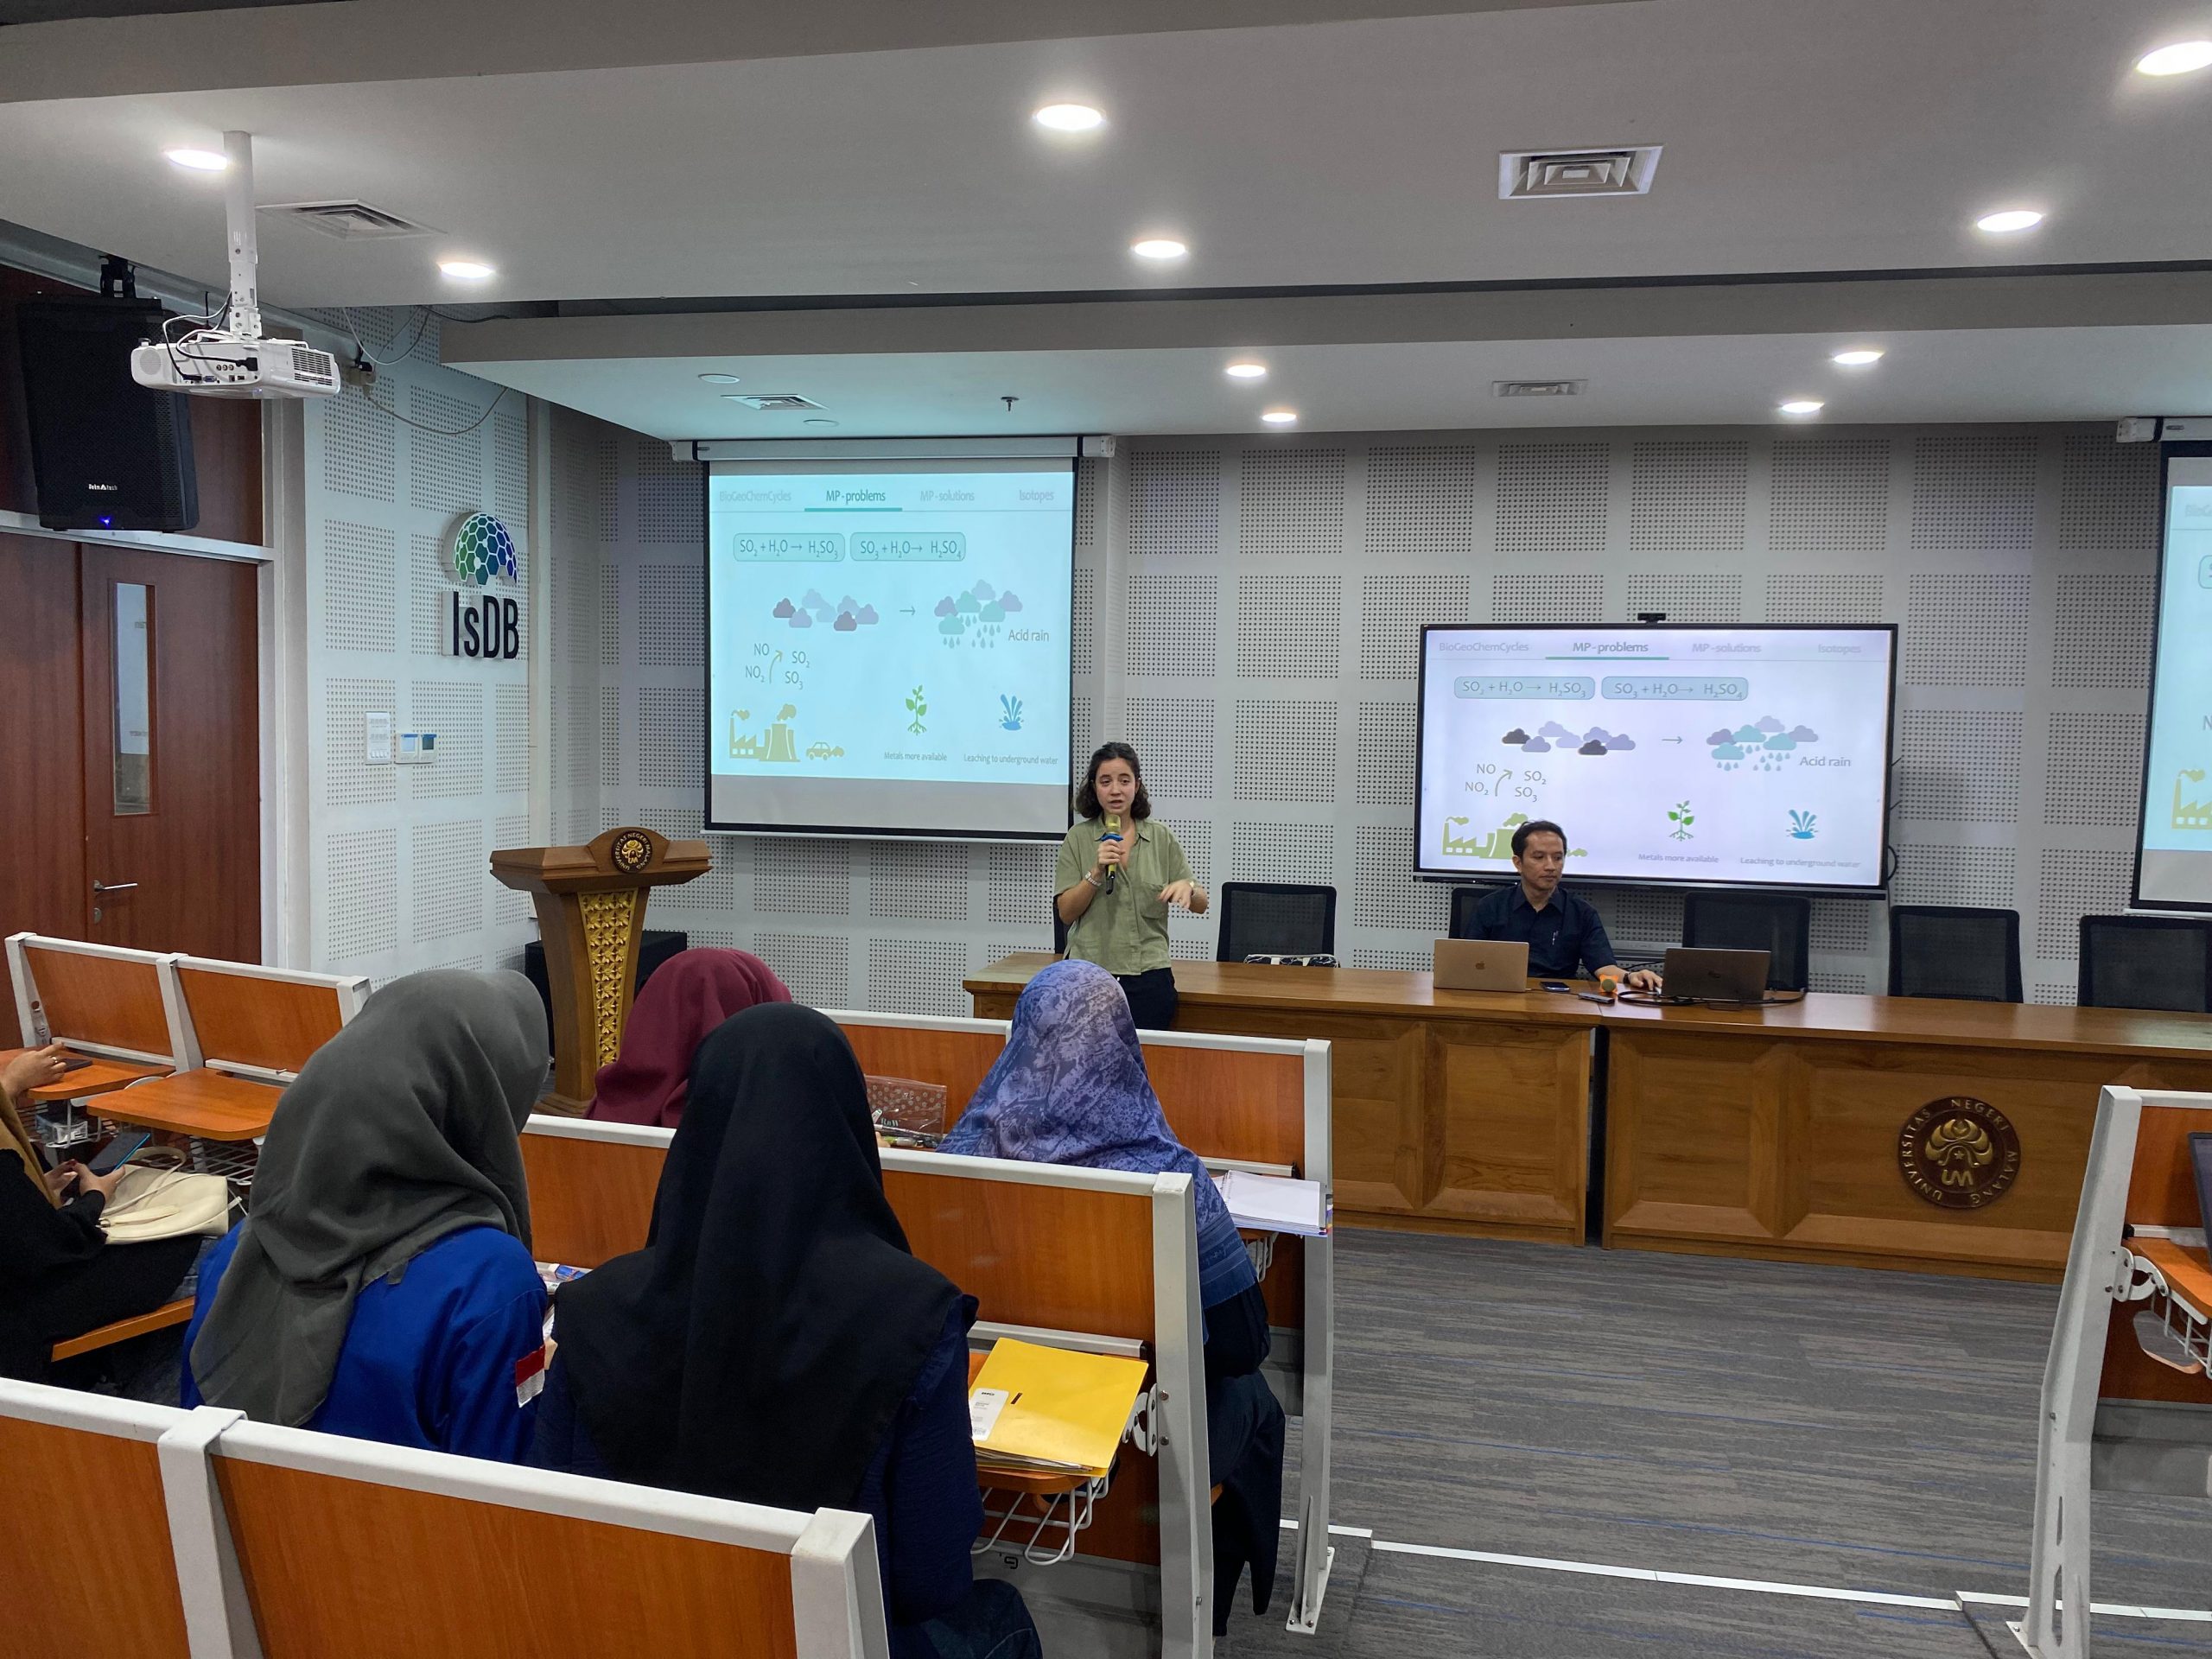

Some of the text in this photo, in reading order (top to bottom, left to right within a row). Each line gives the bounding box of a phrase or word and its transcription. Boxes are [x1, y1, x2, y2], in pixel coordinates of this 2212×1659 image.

[1019, 489, 1055, 504] Isotopes
[452, 590, 519, 660] IsDB
[1007, 628, 1050, 642] Acid rain
[753, 642, 770, 657] NO
[1439, 642, 1529, 654] BioGeoChemCycles
[1817, 643, 1862, 656] Isotopes
[884, 751, 904, 760] Metals
[921, 752, 948, 761] available
[963, 753, 1058, 766] Leaching to underground water
[1799, 756, 1851, 767] Acid rain
[1477, 763, 1497, 775] NO
[1638, 853, 1664, 862] Metals
[1686, 855, 1719, 863] available
[1740, 856, 1774, 867] Leaching
[1902, 1098, 2019, 1204] UNIVERSITAS NEGERI MALANG
[1941, 1169, 1974, 1187] UM
